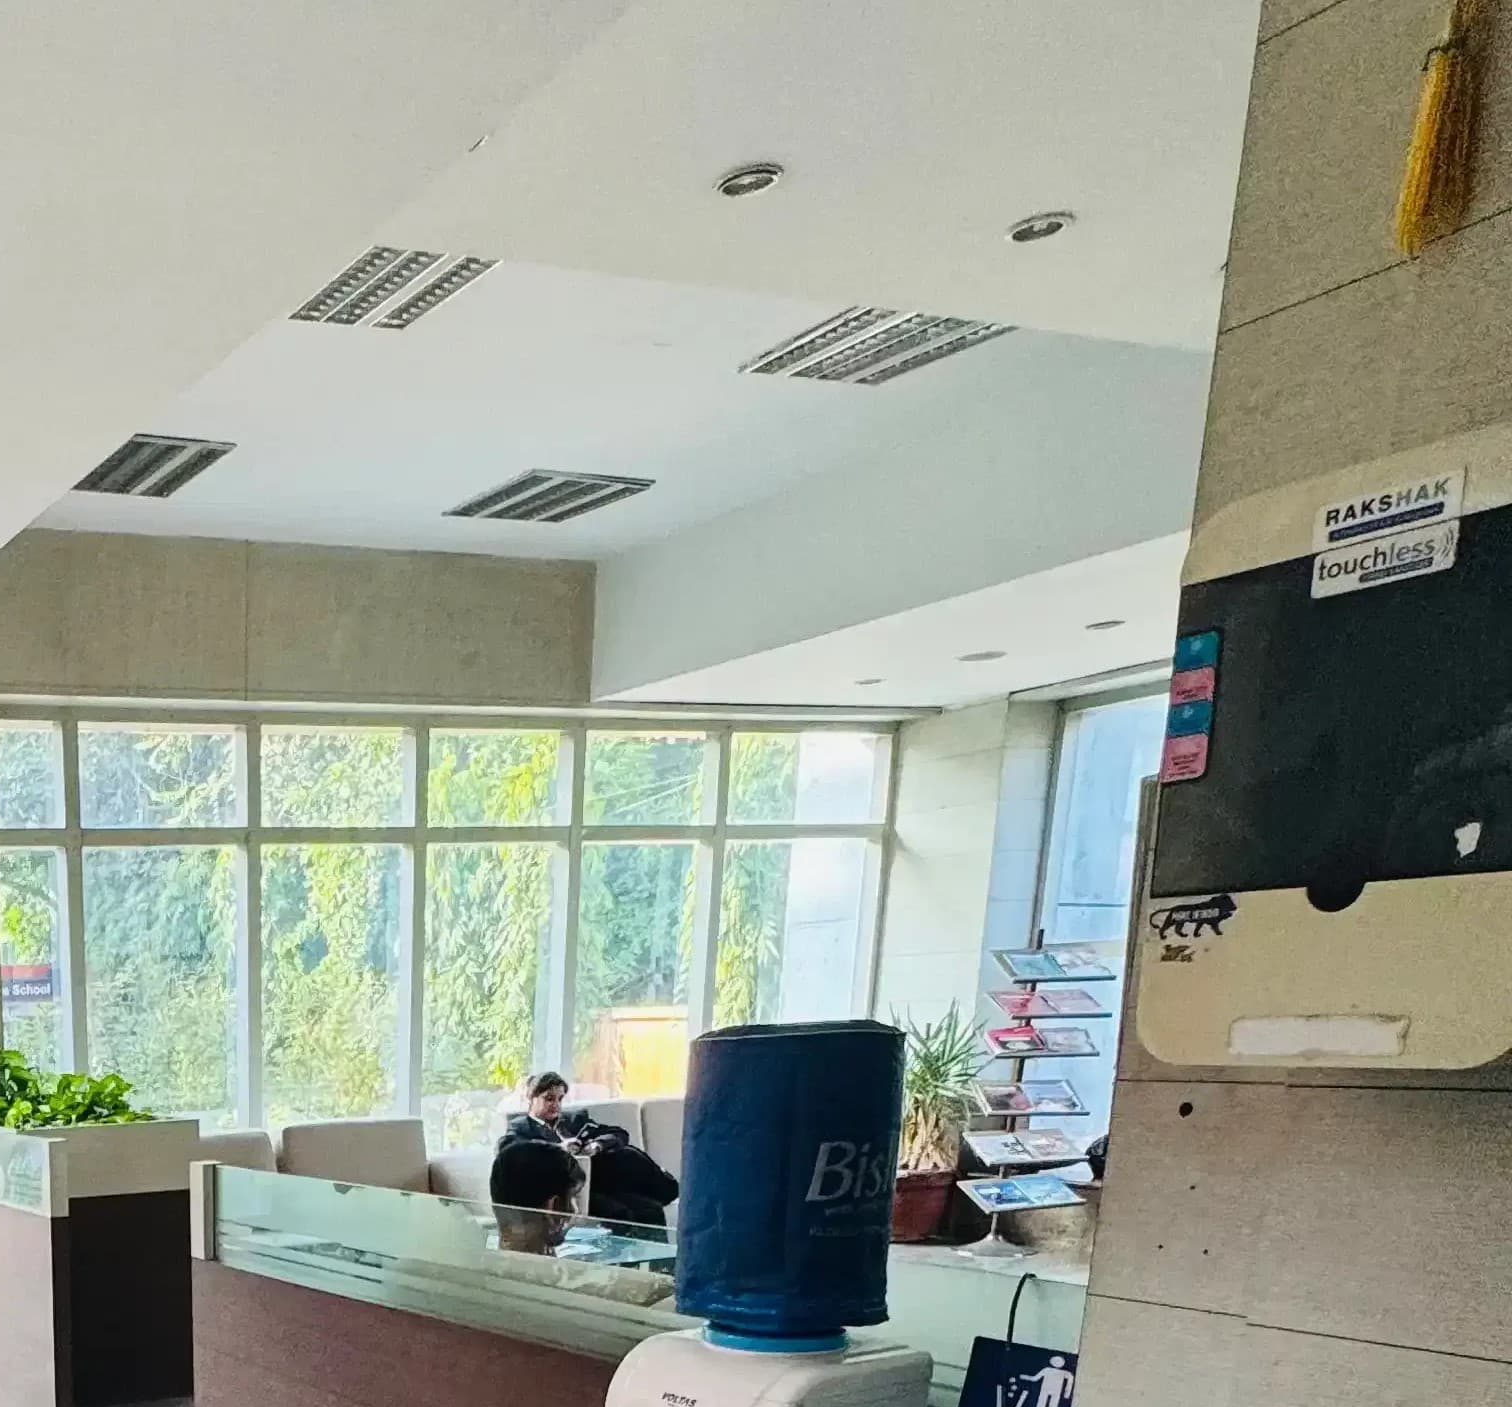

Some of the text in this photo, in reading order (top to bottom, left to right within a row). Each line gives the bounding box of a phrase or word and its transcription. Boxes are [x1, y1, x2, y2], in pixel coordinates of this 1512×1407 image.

[1325, 476, 1451, 528] RAKSHAK
[1318, 539, 1436, 581] touchless
[12, 983, 51, 996] School
[661, 1391, 697, 1407] VOLTAS
